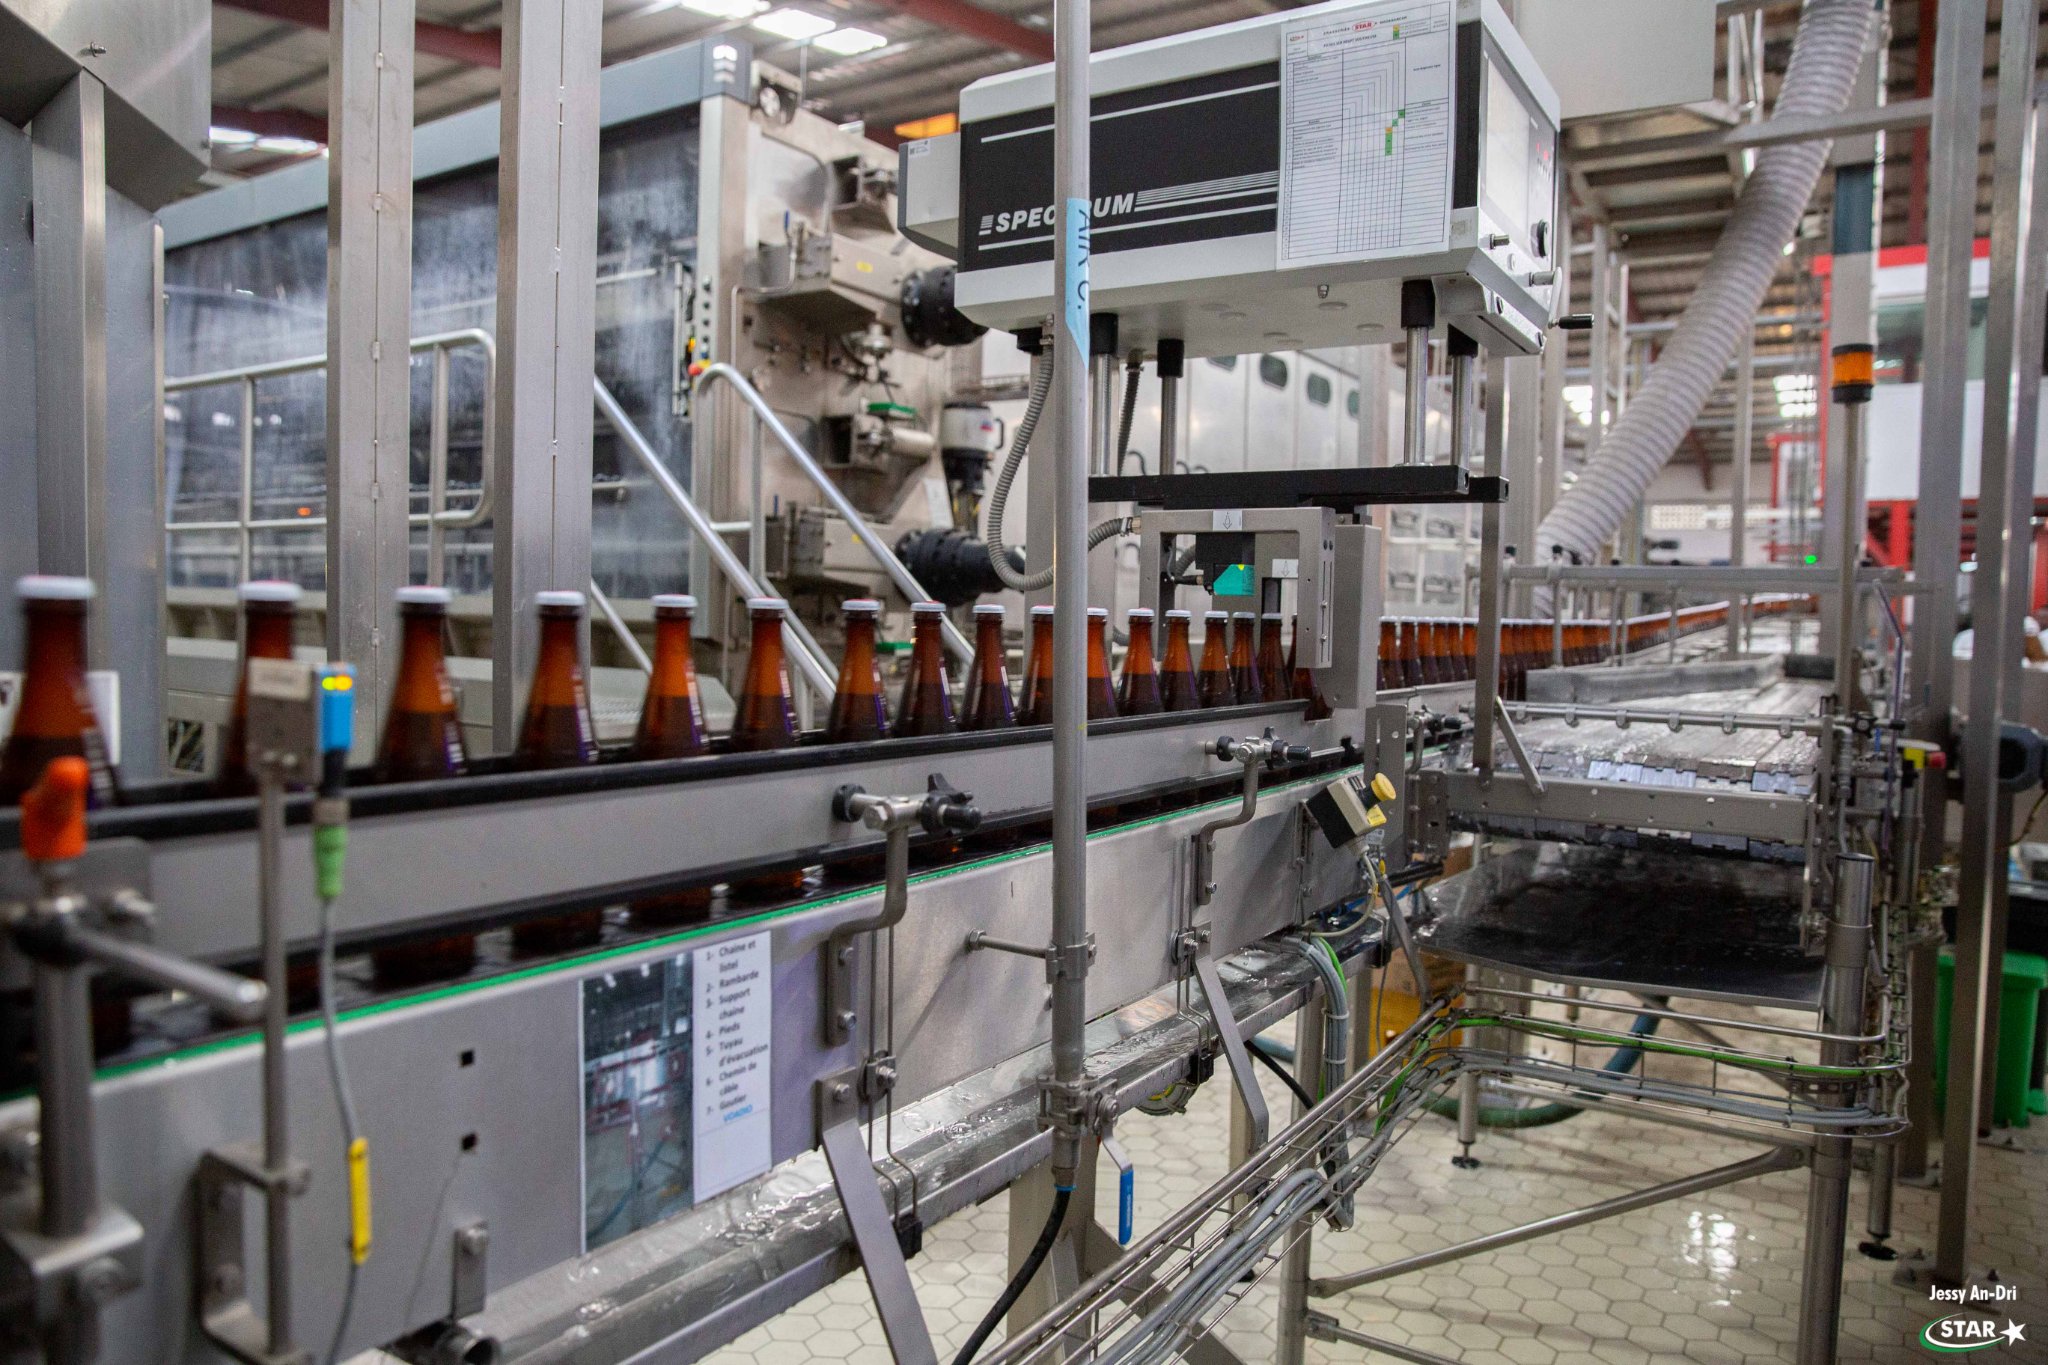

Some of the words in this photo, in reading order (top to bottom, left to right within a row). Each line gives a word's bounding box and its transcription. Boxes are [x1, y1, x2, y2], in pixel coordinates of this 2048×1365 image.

[1354, 22, 1372, 30] STAR
[995, 193, 1135, 233] SPECUM
[748, 940, 756, 950] et
[719, 970, 759, 987] Rambarde
[719, 988, 751, 1004] Support
[719, 1022, 740, 1035] Pieds
[719, 1038, 743, 1050] Tuyau
[719, 1066, 747, 1081] Chemin
[748, 1062, 757, 1071] de
